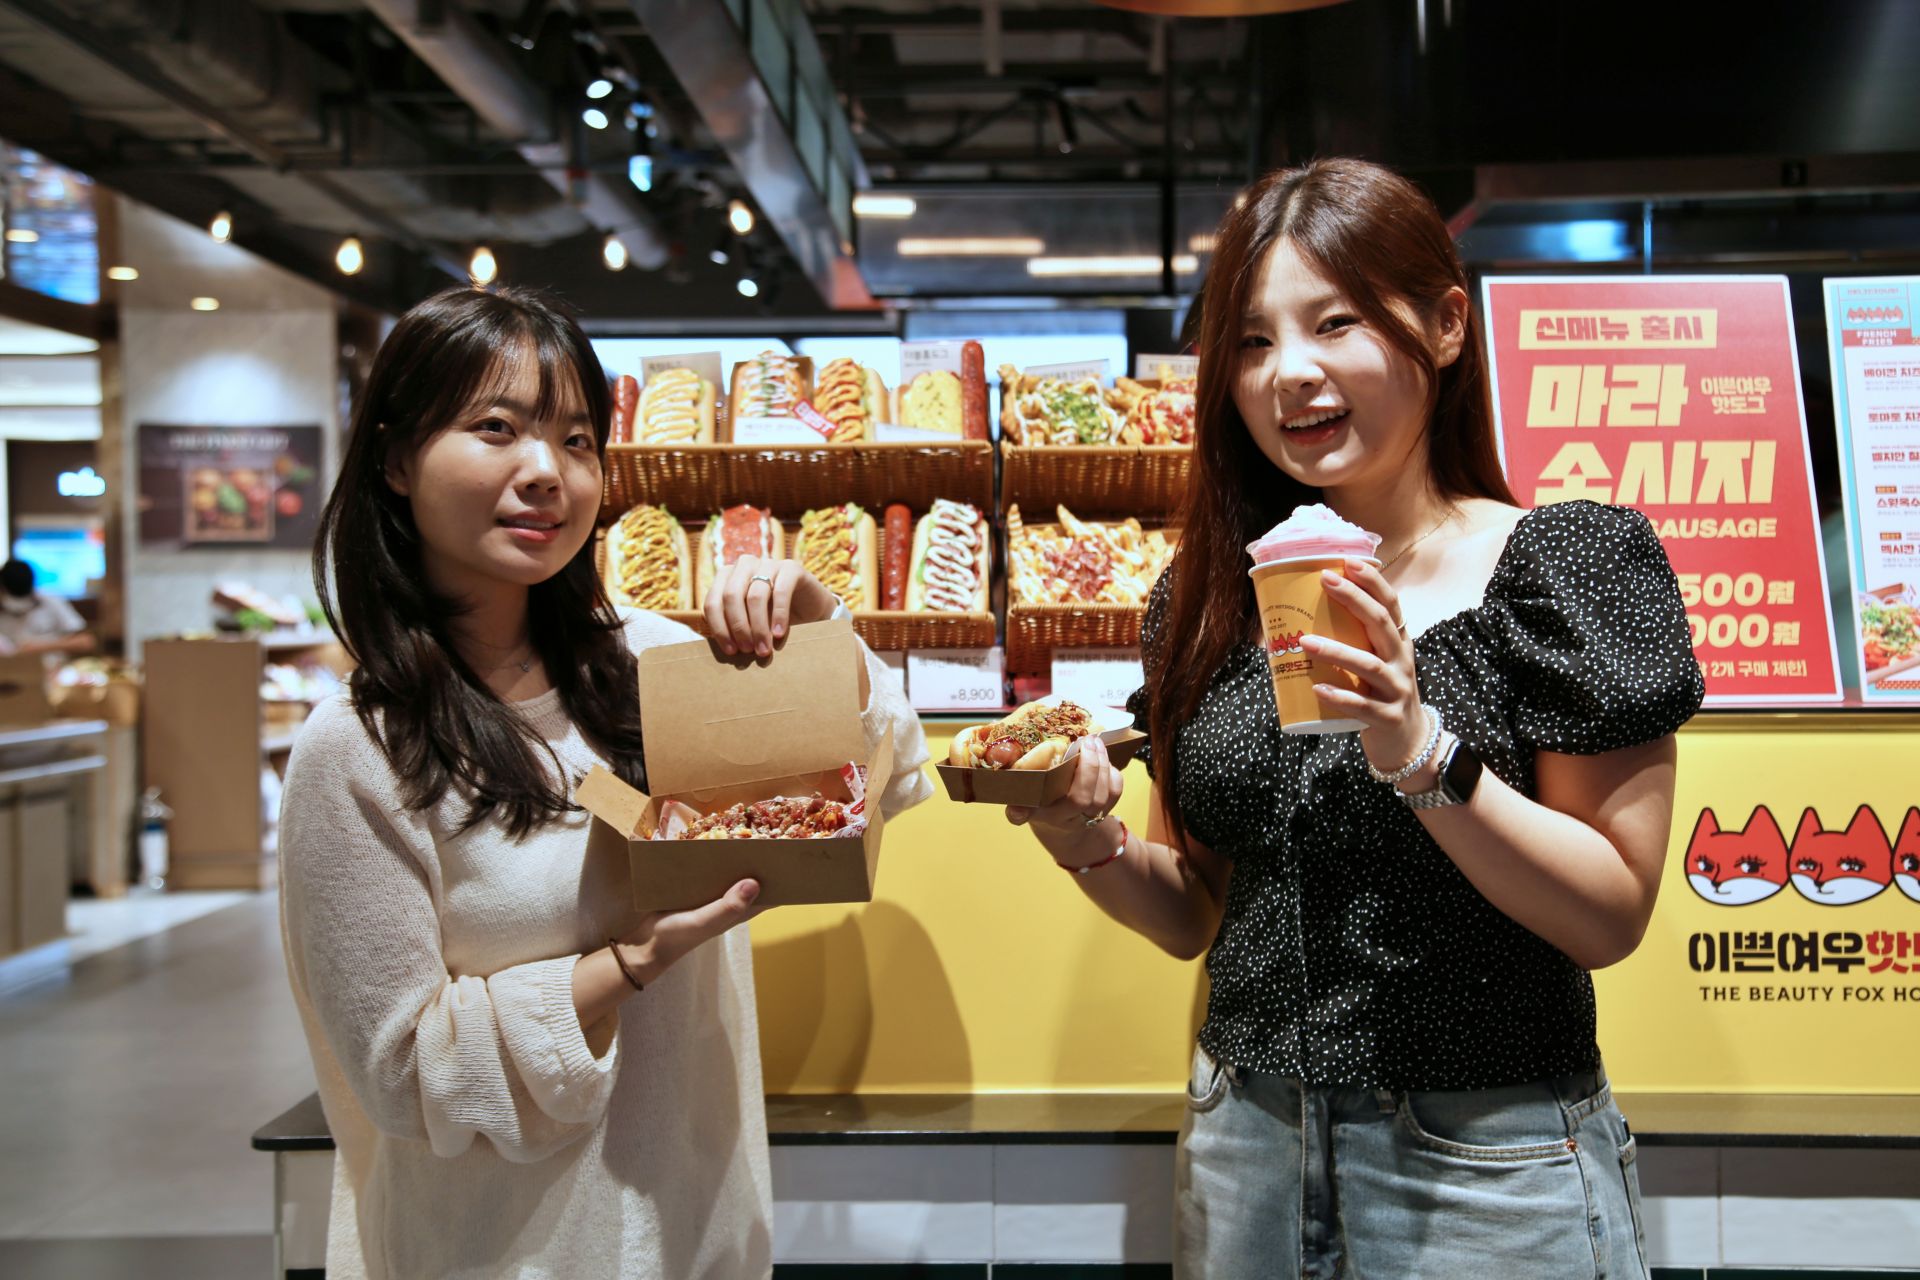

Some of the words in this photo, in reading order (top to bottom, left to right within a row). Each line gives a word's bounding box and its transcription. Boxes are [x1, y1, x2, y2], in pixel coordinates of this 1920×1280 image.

[1536, 317, 1629, 341] 신메뉴
[1641, 315, 1703, 341] 출시
[1526, 364, 1689, 428] 마라
[1701, 376, 1772, 396] 이쁜여우
[1905, 412, 1920, 422] 치
[1534, 440, 1777, 505] 소시지
[1711, 660, 1735, 677] 2개
[1739, 660, 1769, 677] 구매
[1689, 931, 1920, 974] 이쁜여우핫
[1700, 986, 1740, 1001] THE
[1750, 986, 1834, 1001] BEAUTY
[1843, 986, 1885, 1001] FOX
